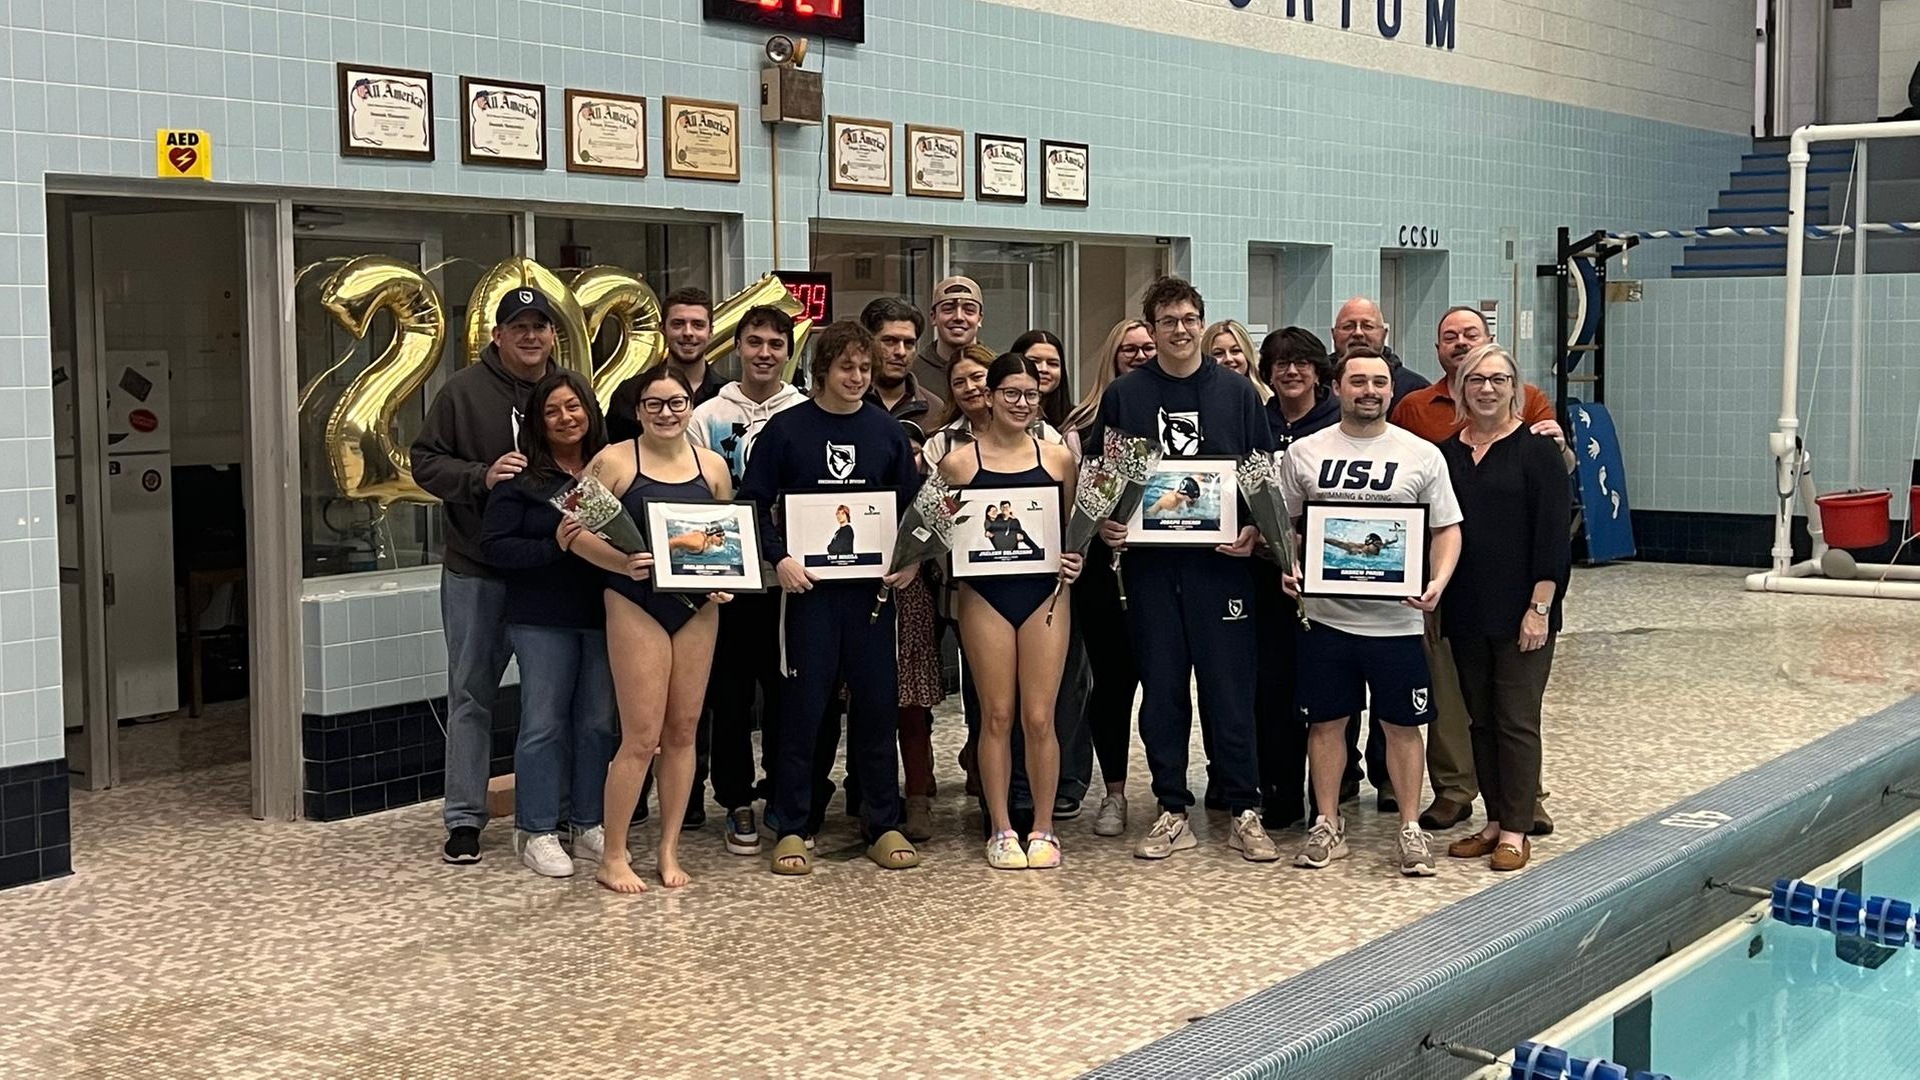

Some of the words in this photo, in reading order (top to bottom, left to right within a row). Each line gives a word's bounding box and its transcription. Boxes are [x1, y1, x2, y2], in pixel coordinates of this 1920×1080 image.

[363, 82, 380, 99] All
[382, 83, 424, 109] America
[482, 95, 498, 110] All
[500, 95, 537, 120] America
[587, 106, 602, 121] All
[604, 105, 637, 128] America
[683, 114, 697, 128] All
[699, 115, 730, 135] America
[167, 132, 199, 146] AED
[846, 131, 858, 144] All
[920, 138, 933, 152] All
[1399, 224, 1439, 248] CCSU
[1318, 459, 1399, 492] USJ
[1365, 493, 1392, 502] DIVING
